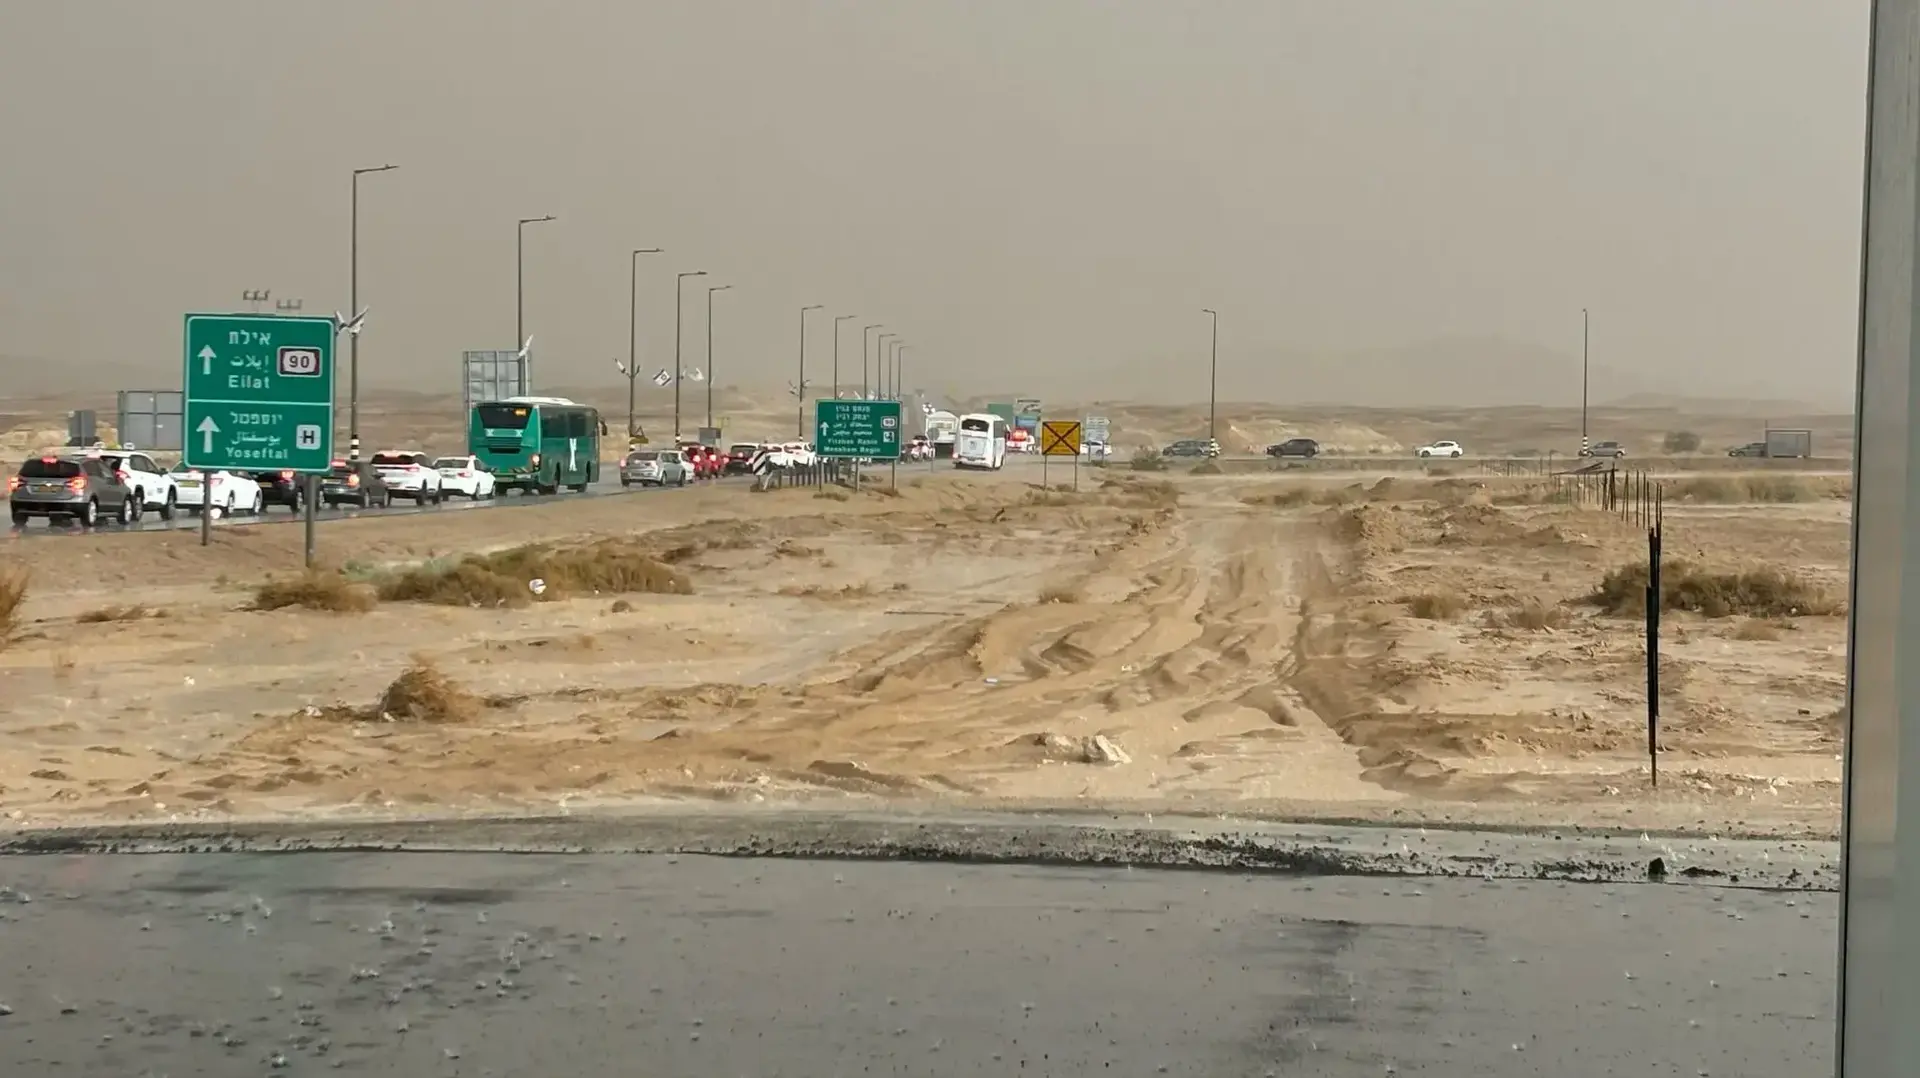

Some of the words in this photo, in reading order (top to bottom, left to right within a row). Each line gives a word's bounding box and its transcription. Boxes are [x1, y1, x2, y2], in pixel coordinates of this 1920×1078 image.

[229, 330, 271, 345] אילת
[289, 355, 310, 368] 90
[228, 375, 270, 389] Eilat
[230, 411, 283, 425] יוספטל
[302, 430, 315, 444] H
[225, 446, 288, 459] Yoseftal
